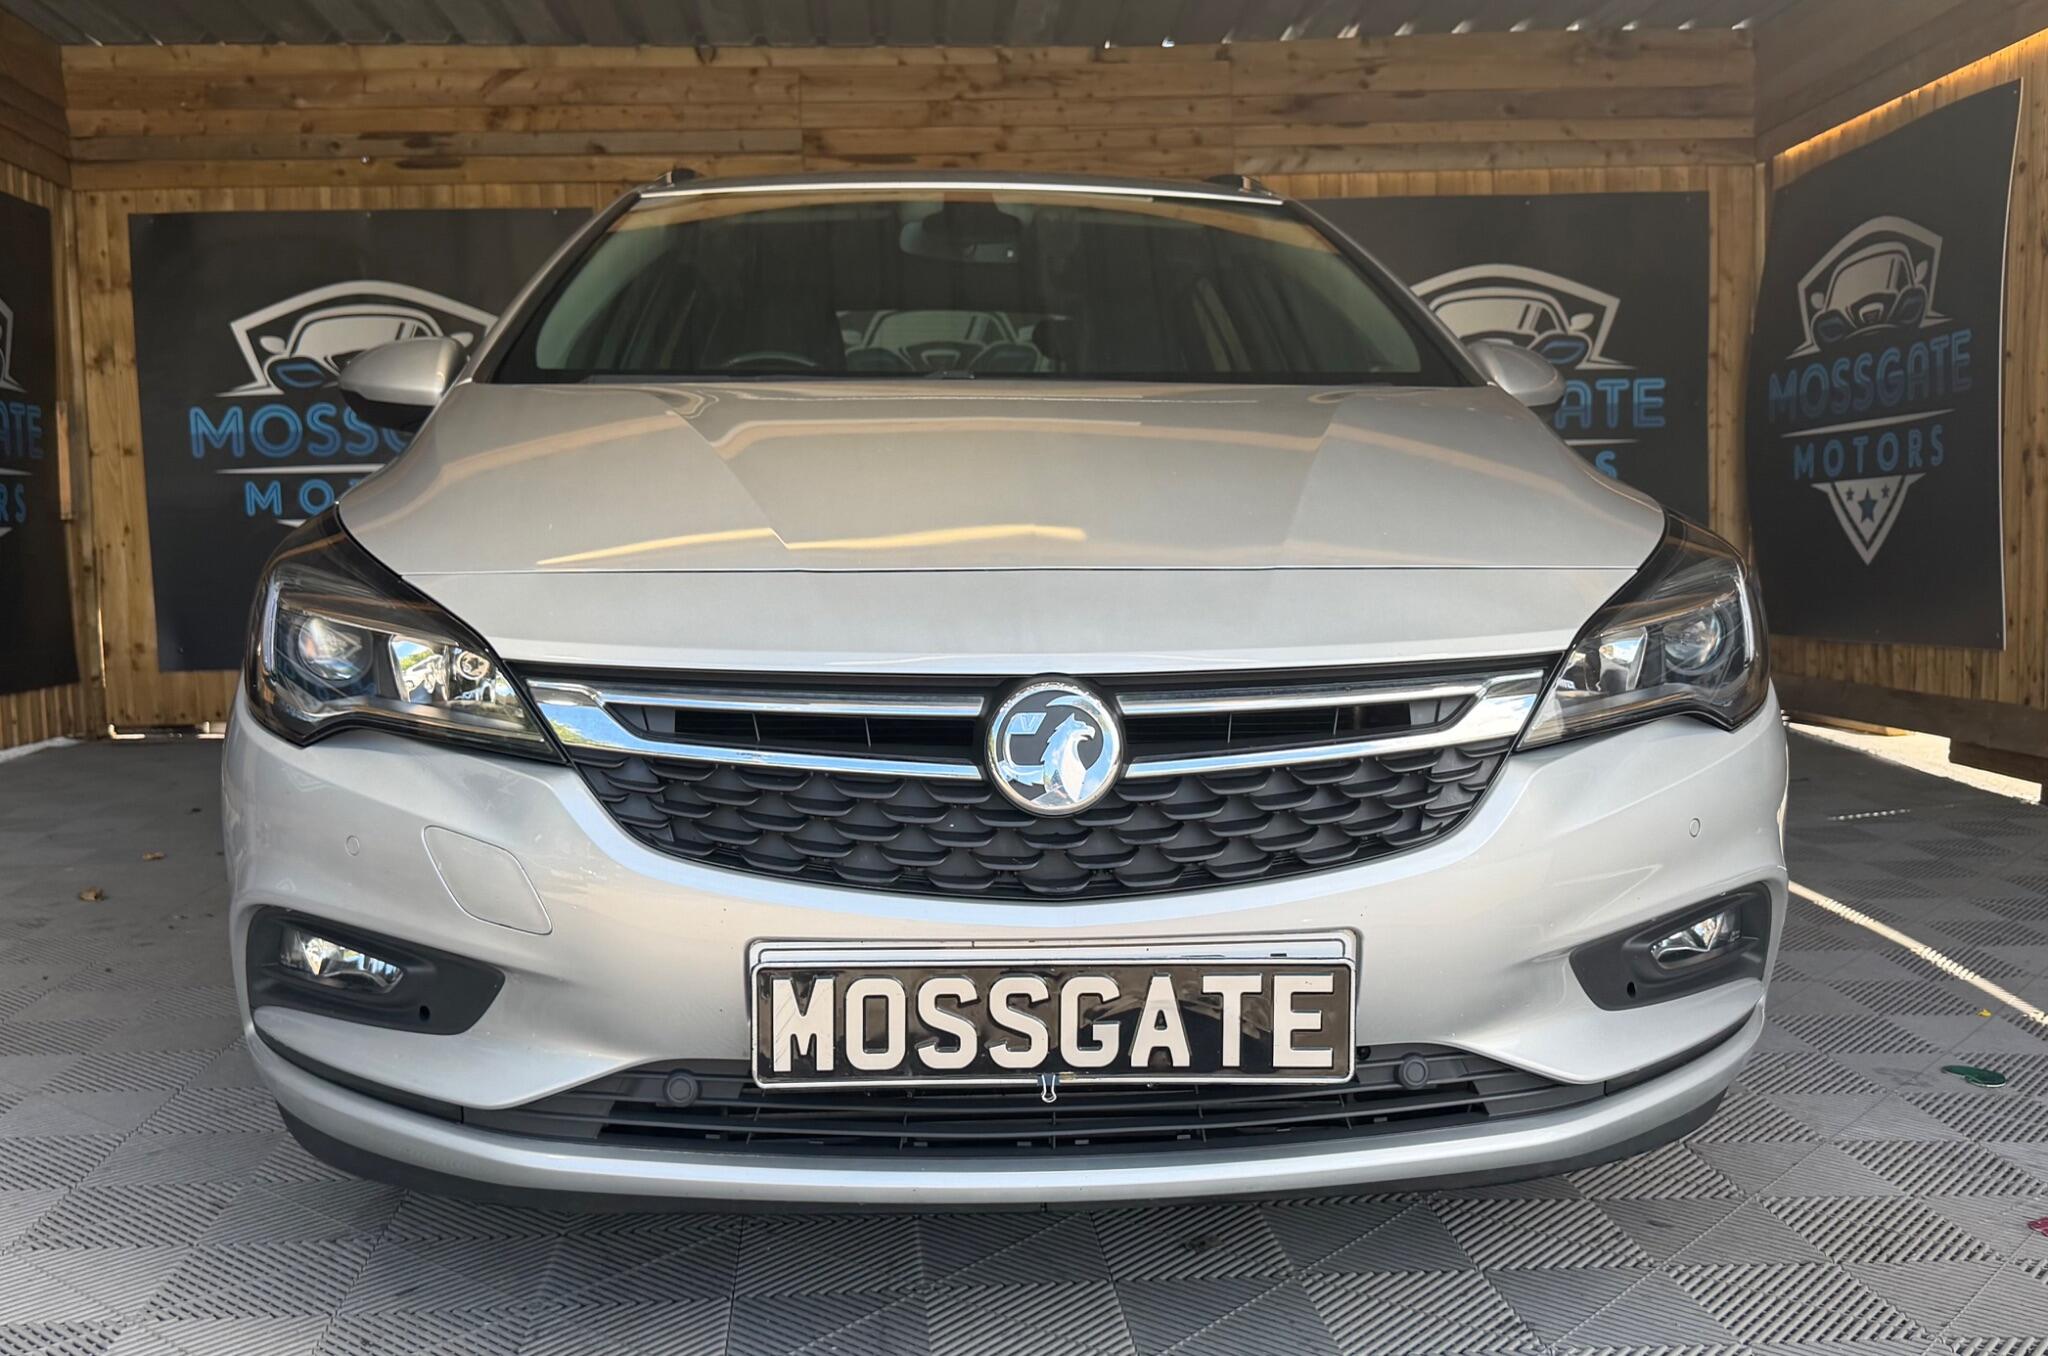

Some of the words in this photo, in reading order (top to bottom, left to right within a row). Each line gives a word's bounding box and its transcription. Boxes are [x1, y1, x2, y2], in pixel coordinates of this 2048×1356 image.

[1768, 328, 1973, 424] MOSSGATE
[1793, 424, 1944, 481] MOTORS
[771, 975, 1335, 1073] MOSSGATE
